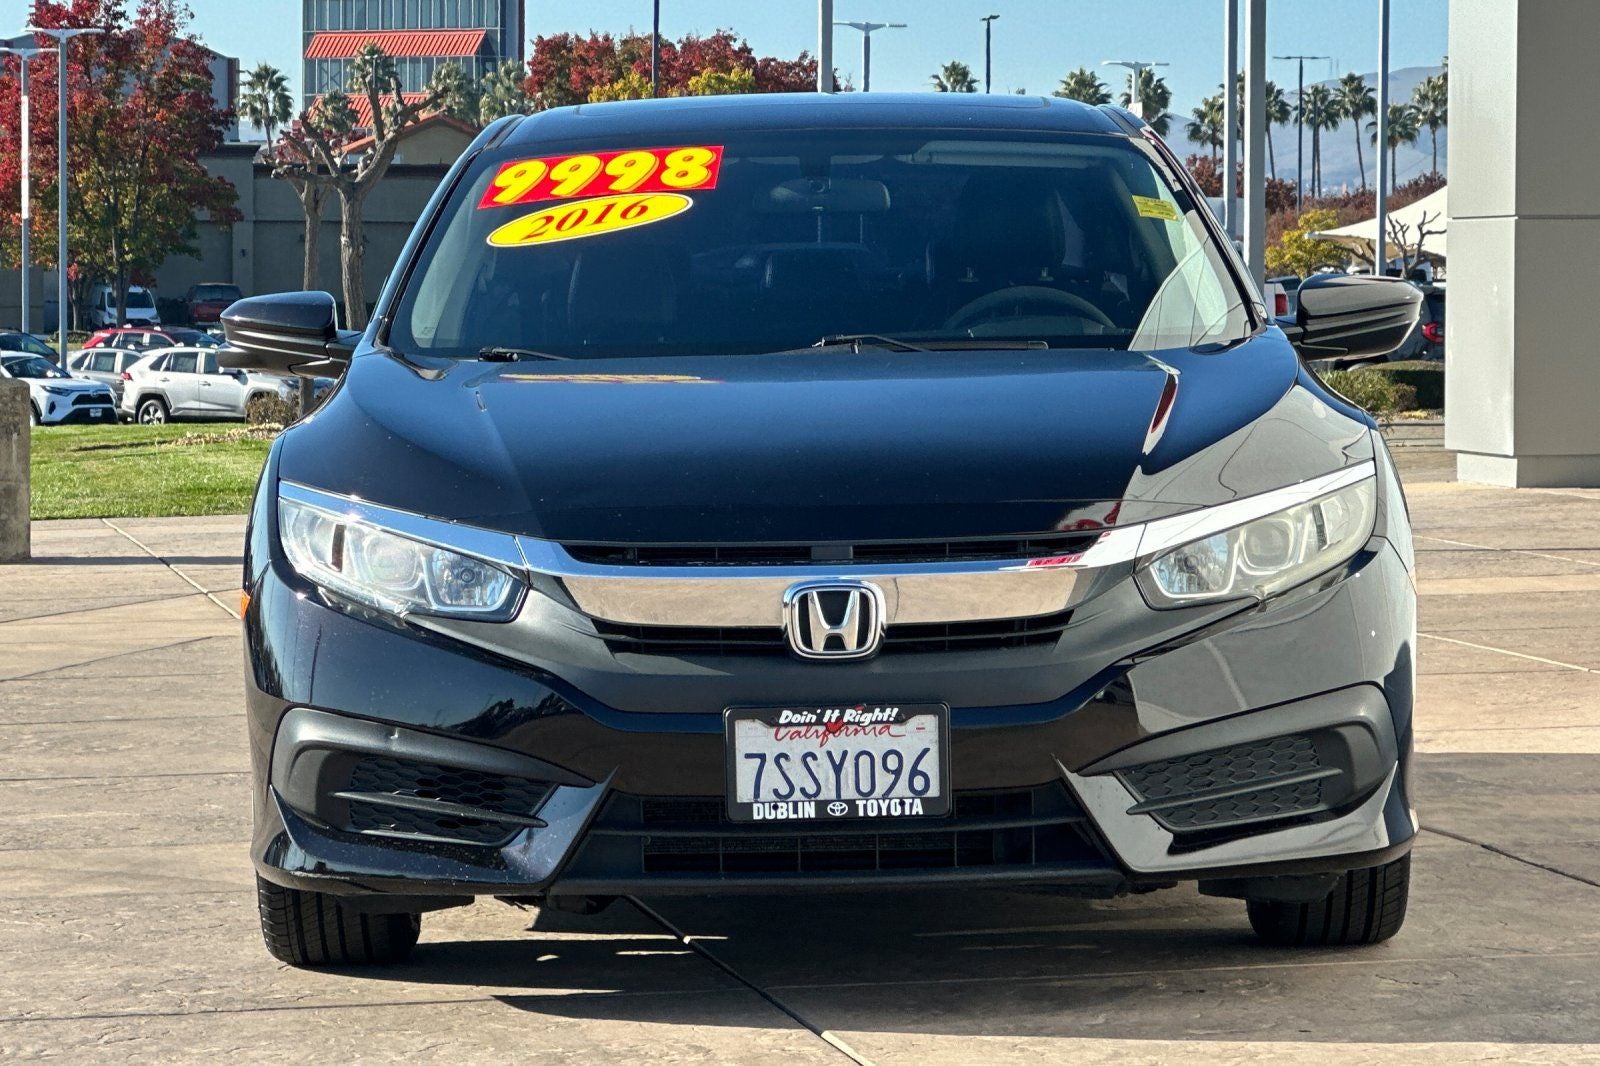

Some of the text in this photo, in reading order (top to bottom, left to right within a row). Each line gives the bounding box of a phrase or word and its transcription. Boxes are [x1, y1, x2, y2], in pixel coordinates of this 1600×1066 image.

[493, 147, 717, 205] 9998
[520, 196, 649, 241] 2016
[779, 707, 899, 726] Doin' It Right!
[744, 748, 931, 801] 7SSY096
[752, 798, 924, 820] DUBLIN TOYOTA
